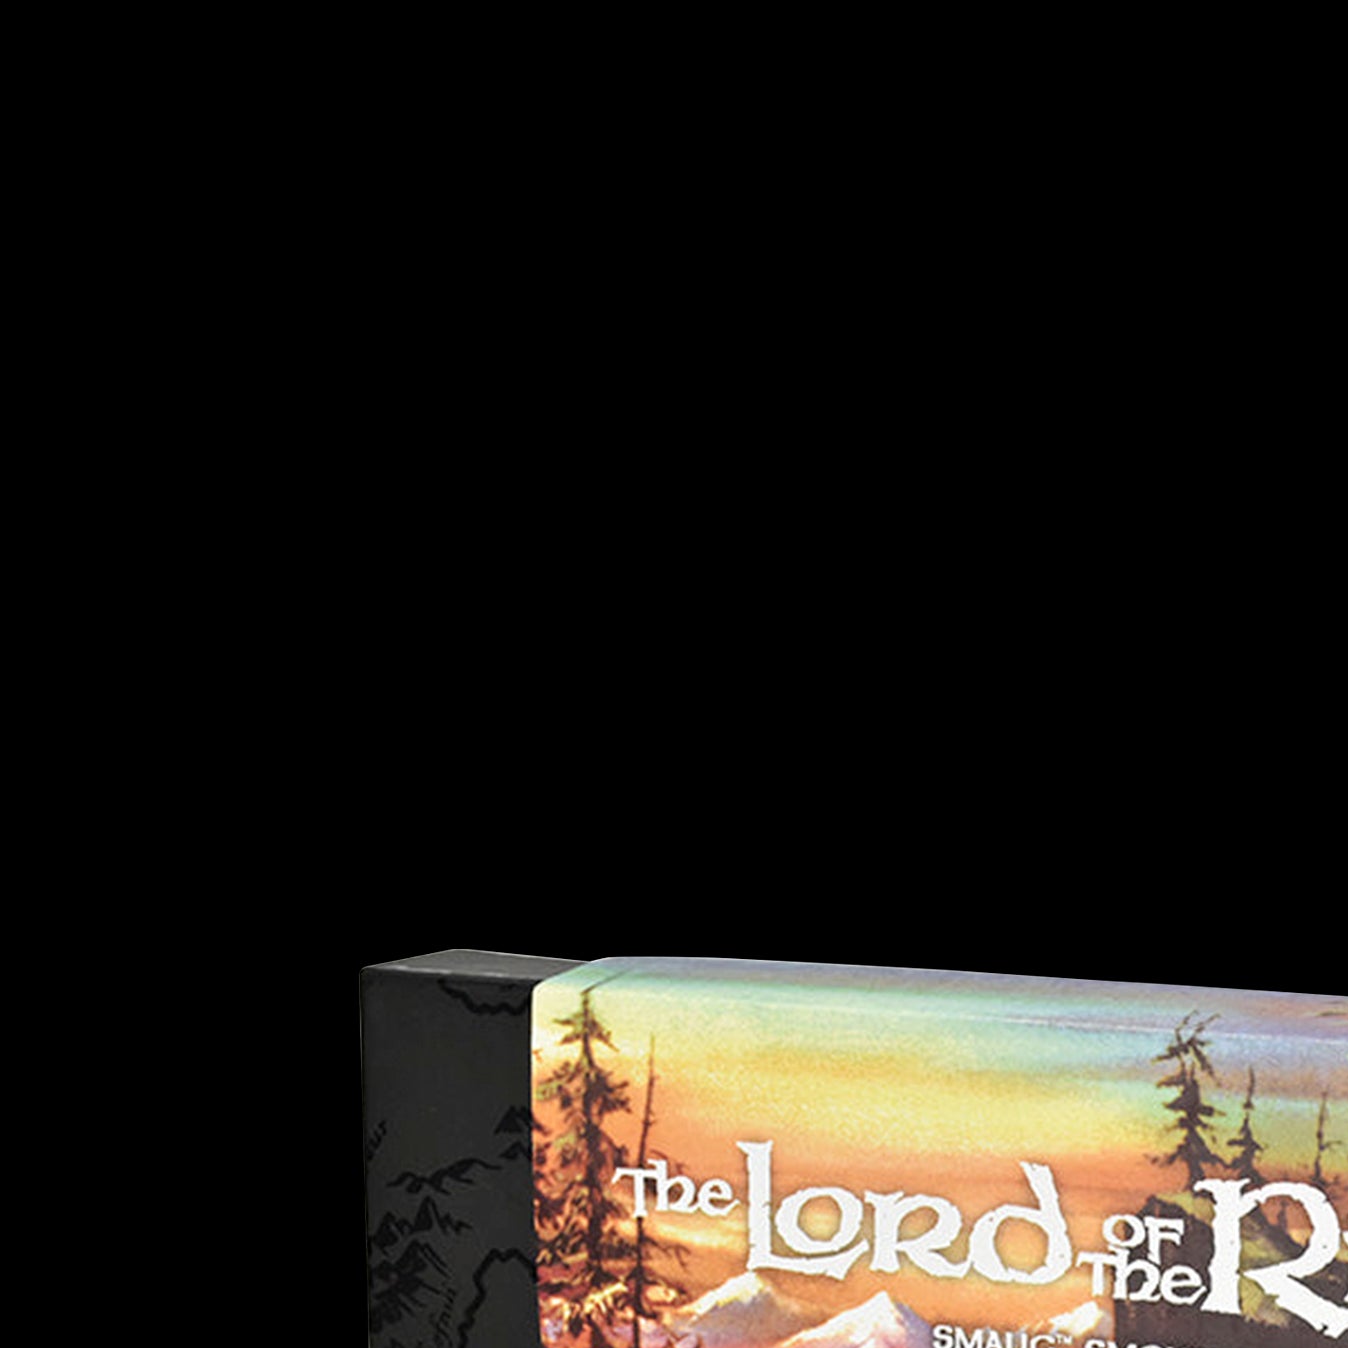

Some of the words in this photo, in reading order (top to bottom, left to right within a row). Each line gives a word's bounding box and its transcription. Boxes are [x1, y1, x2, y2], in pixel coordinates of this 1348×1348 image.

[612, 1158, 740, 1218] The
[736, 1139, 1073, 1285] Lord
[1076, 1245, 1206, 1305] The
